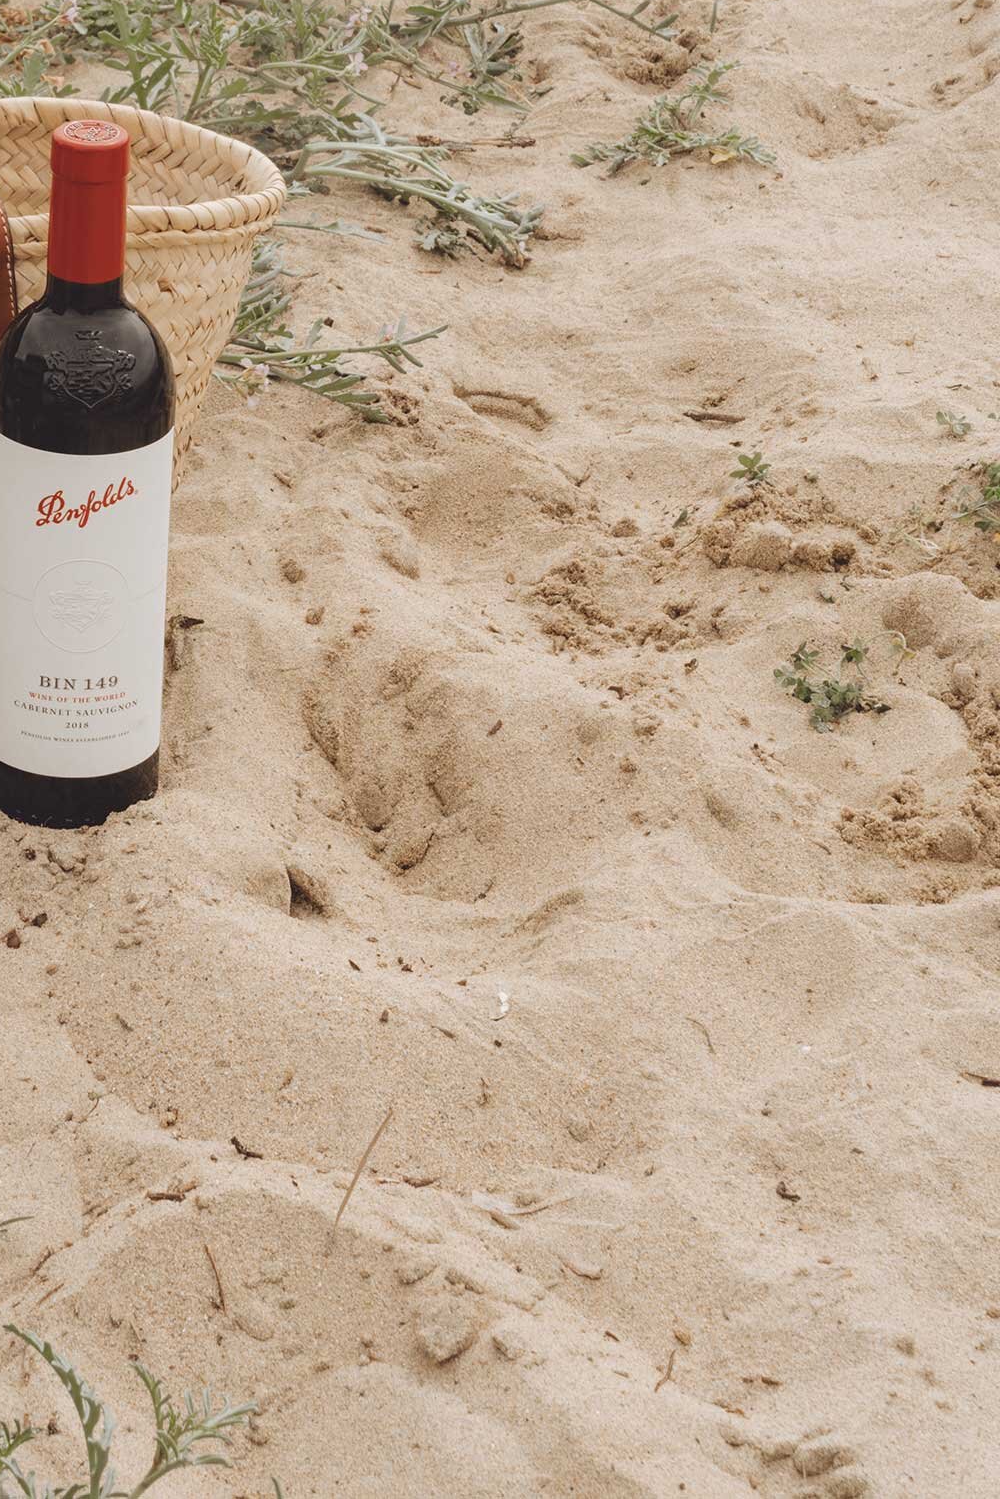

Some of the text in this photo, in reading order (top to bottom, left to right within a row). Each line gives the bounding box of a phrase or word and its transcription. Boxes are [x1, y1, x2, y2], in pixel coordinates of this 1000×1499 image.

[36, 477, 136, 528] Penfolds
[39, 675, 118, 690] BIN 149
[29, 692, 52, 701] WINE
[94, 692, 126, 702] WORLD
[14, 699, 138, 716] CABERNET SAUVIGNON
